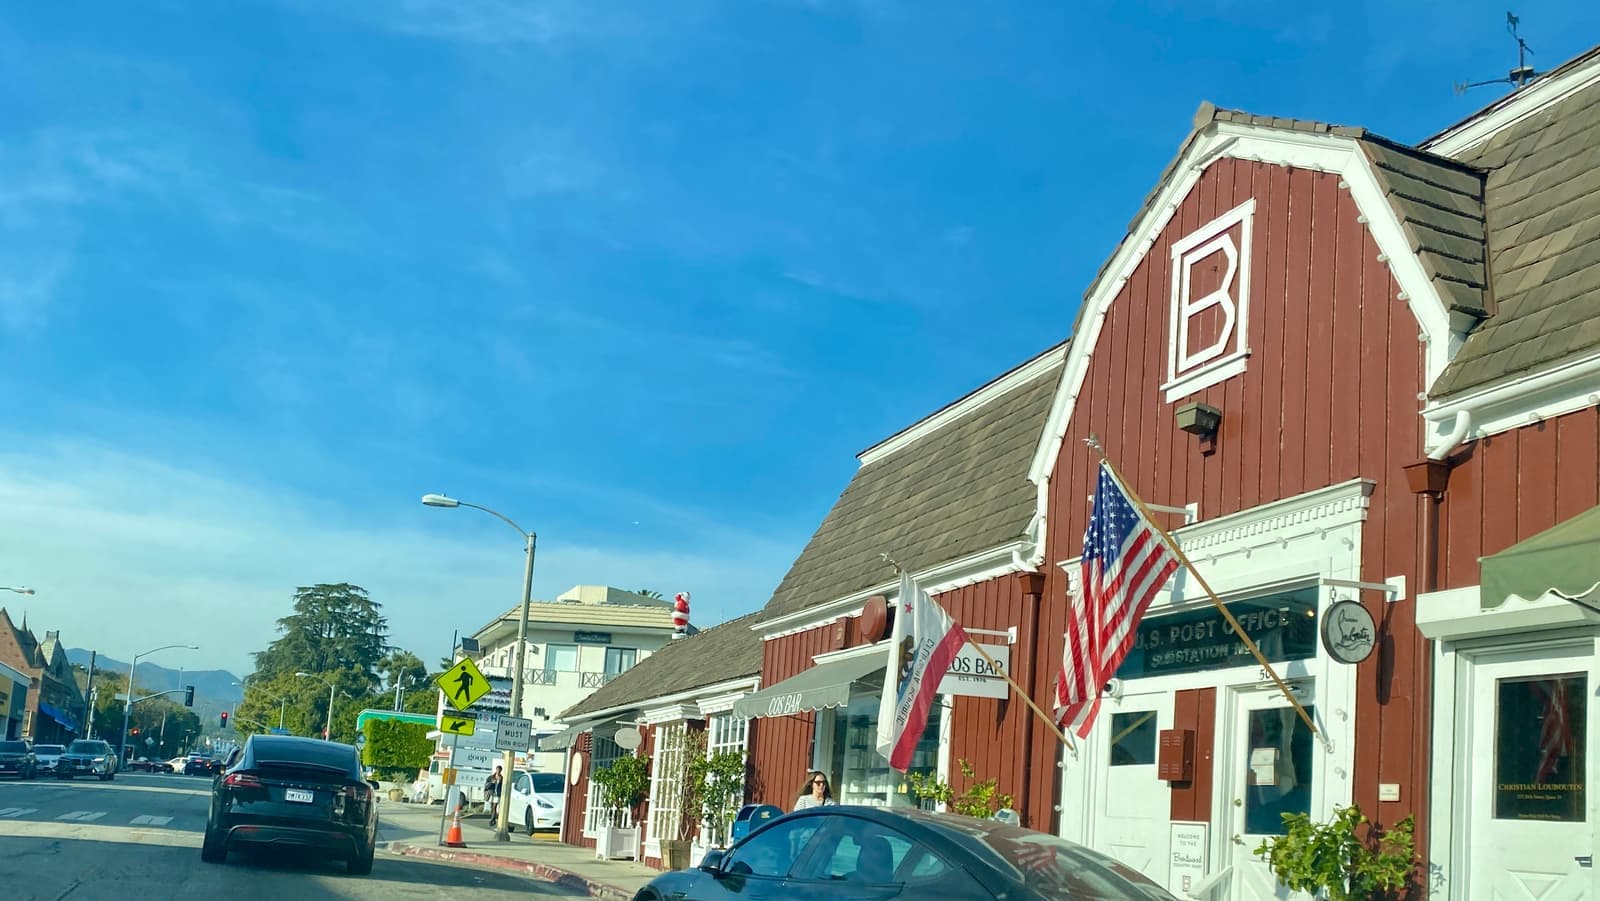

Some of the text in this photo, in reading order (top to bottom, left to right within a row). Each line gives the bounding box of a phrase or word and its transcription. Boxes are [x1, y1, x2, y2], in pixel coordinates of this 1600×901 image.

[1179, 233, 1238, 373] B
[1170, 620, 1217, 642] POST
[1222, 608, 1290, 635] OFFICE
[947, 656, 1003, 675] OS BAR
[1151, 644, 1229, 668] SUBSTATION
[769, 694, 802, 715] COS BAR
[504, 730, 523, 738] MUST
[468, 754, 487, 763] goop
